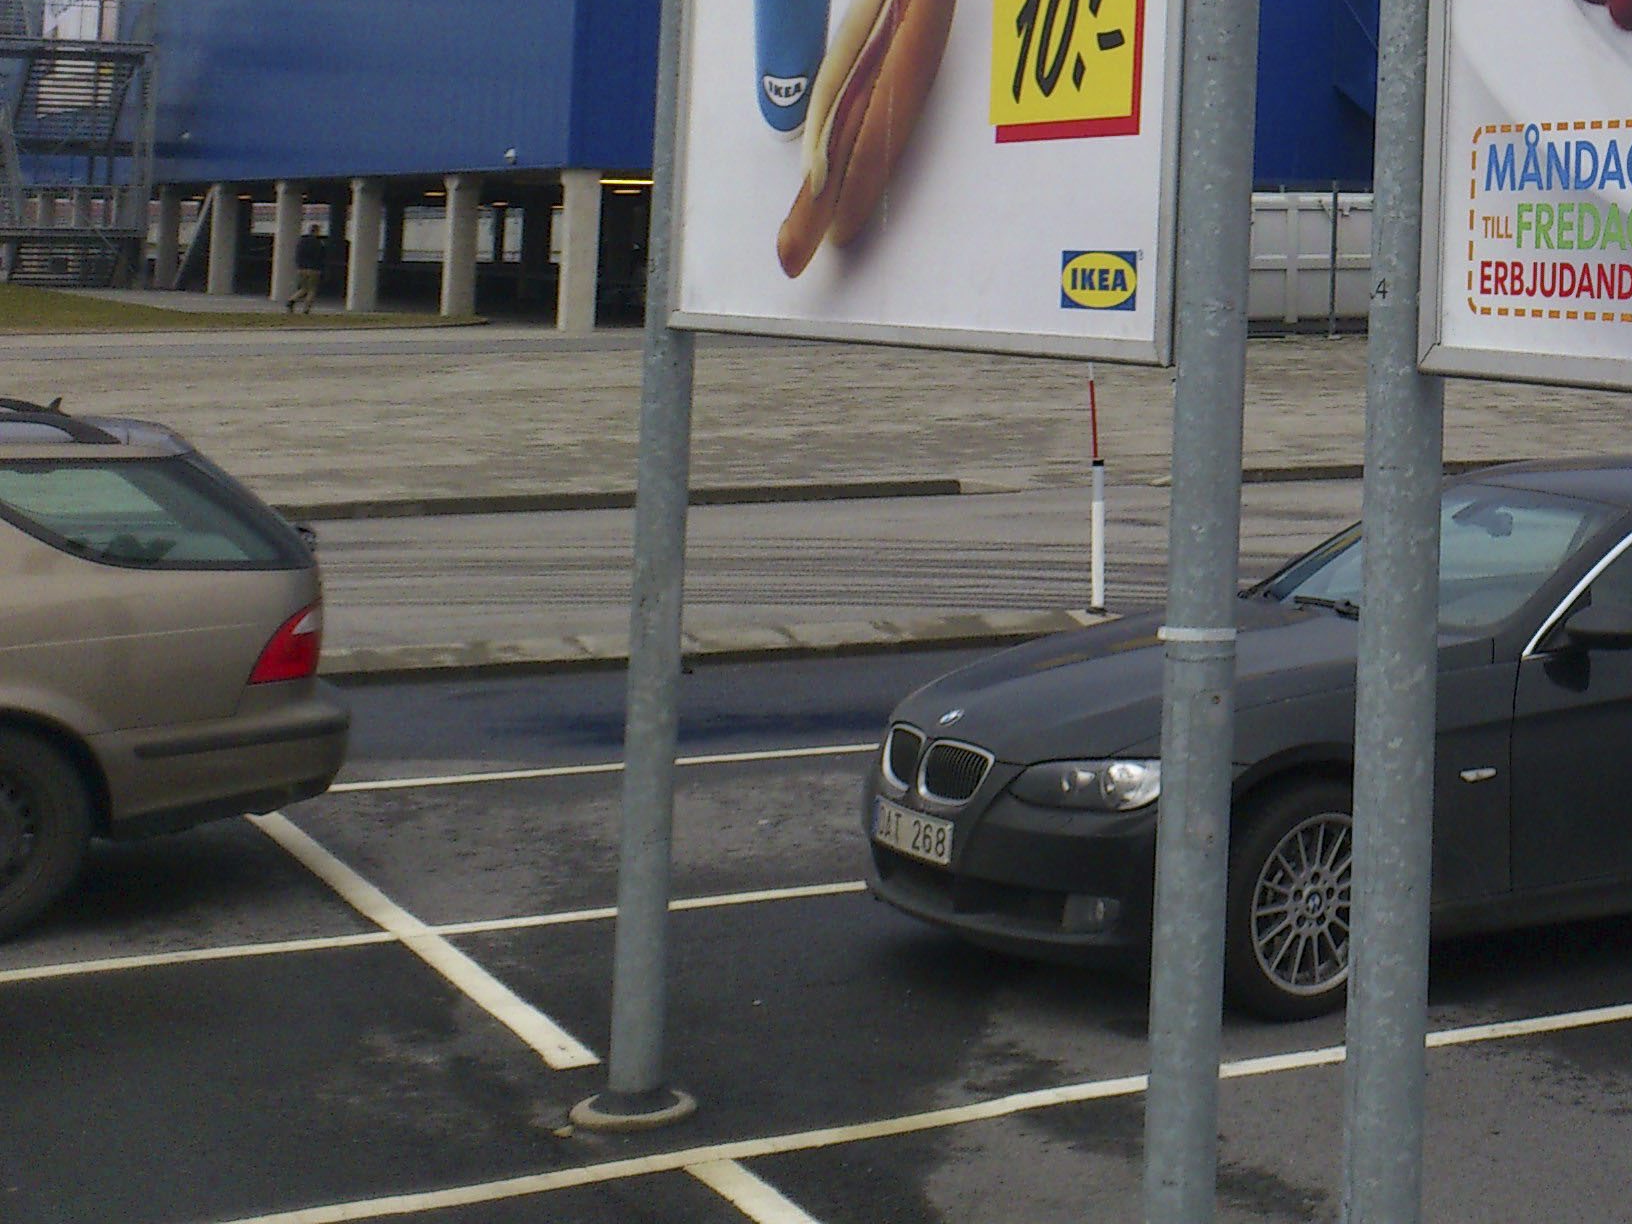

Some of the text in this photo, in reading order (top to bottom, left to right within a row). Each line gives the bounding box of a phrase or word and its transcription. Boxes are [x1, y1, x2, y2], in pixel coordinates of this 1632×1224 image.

[768, 80, 803, 98] IKEA
[1481, 215, 1513, 239] TILL
[1070, 267, 1128, 292] IKEA
[912, 819, 946, 858] 268
